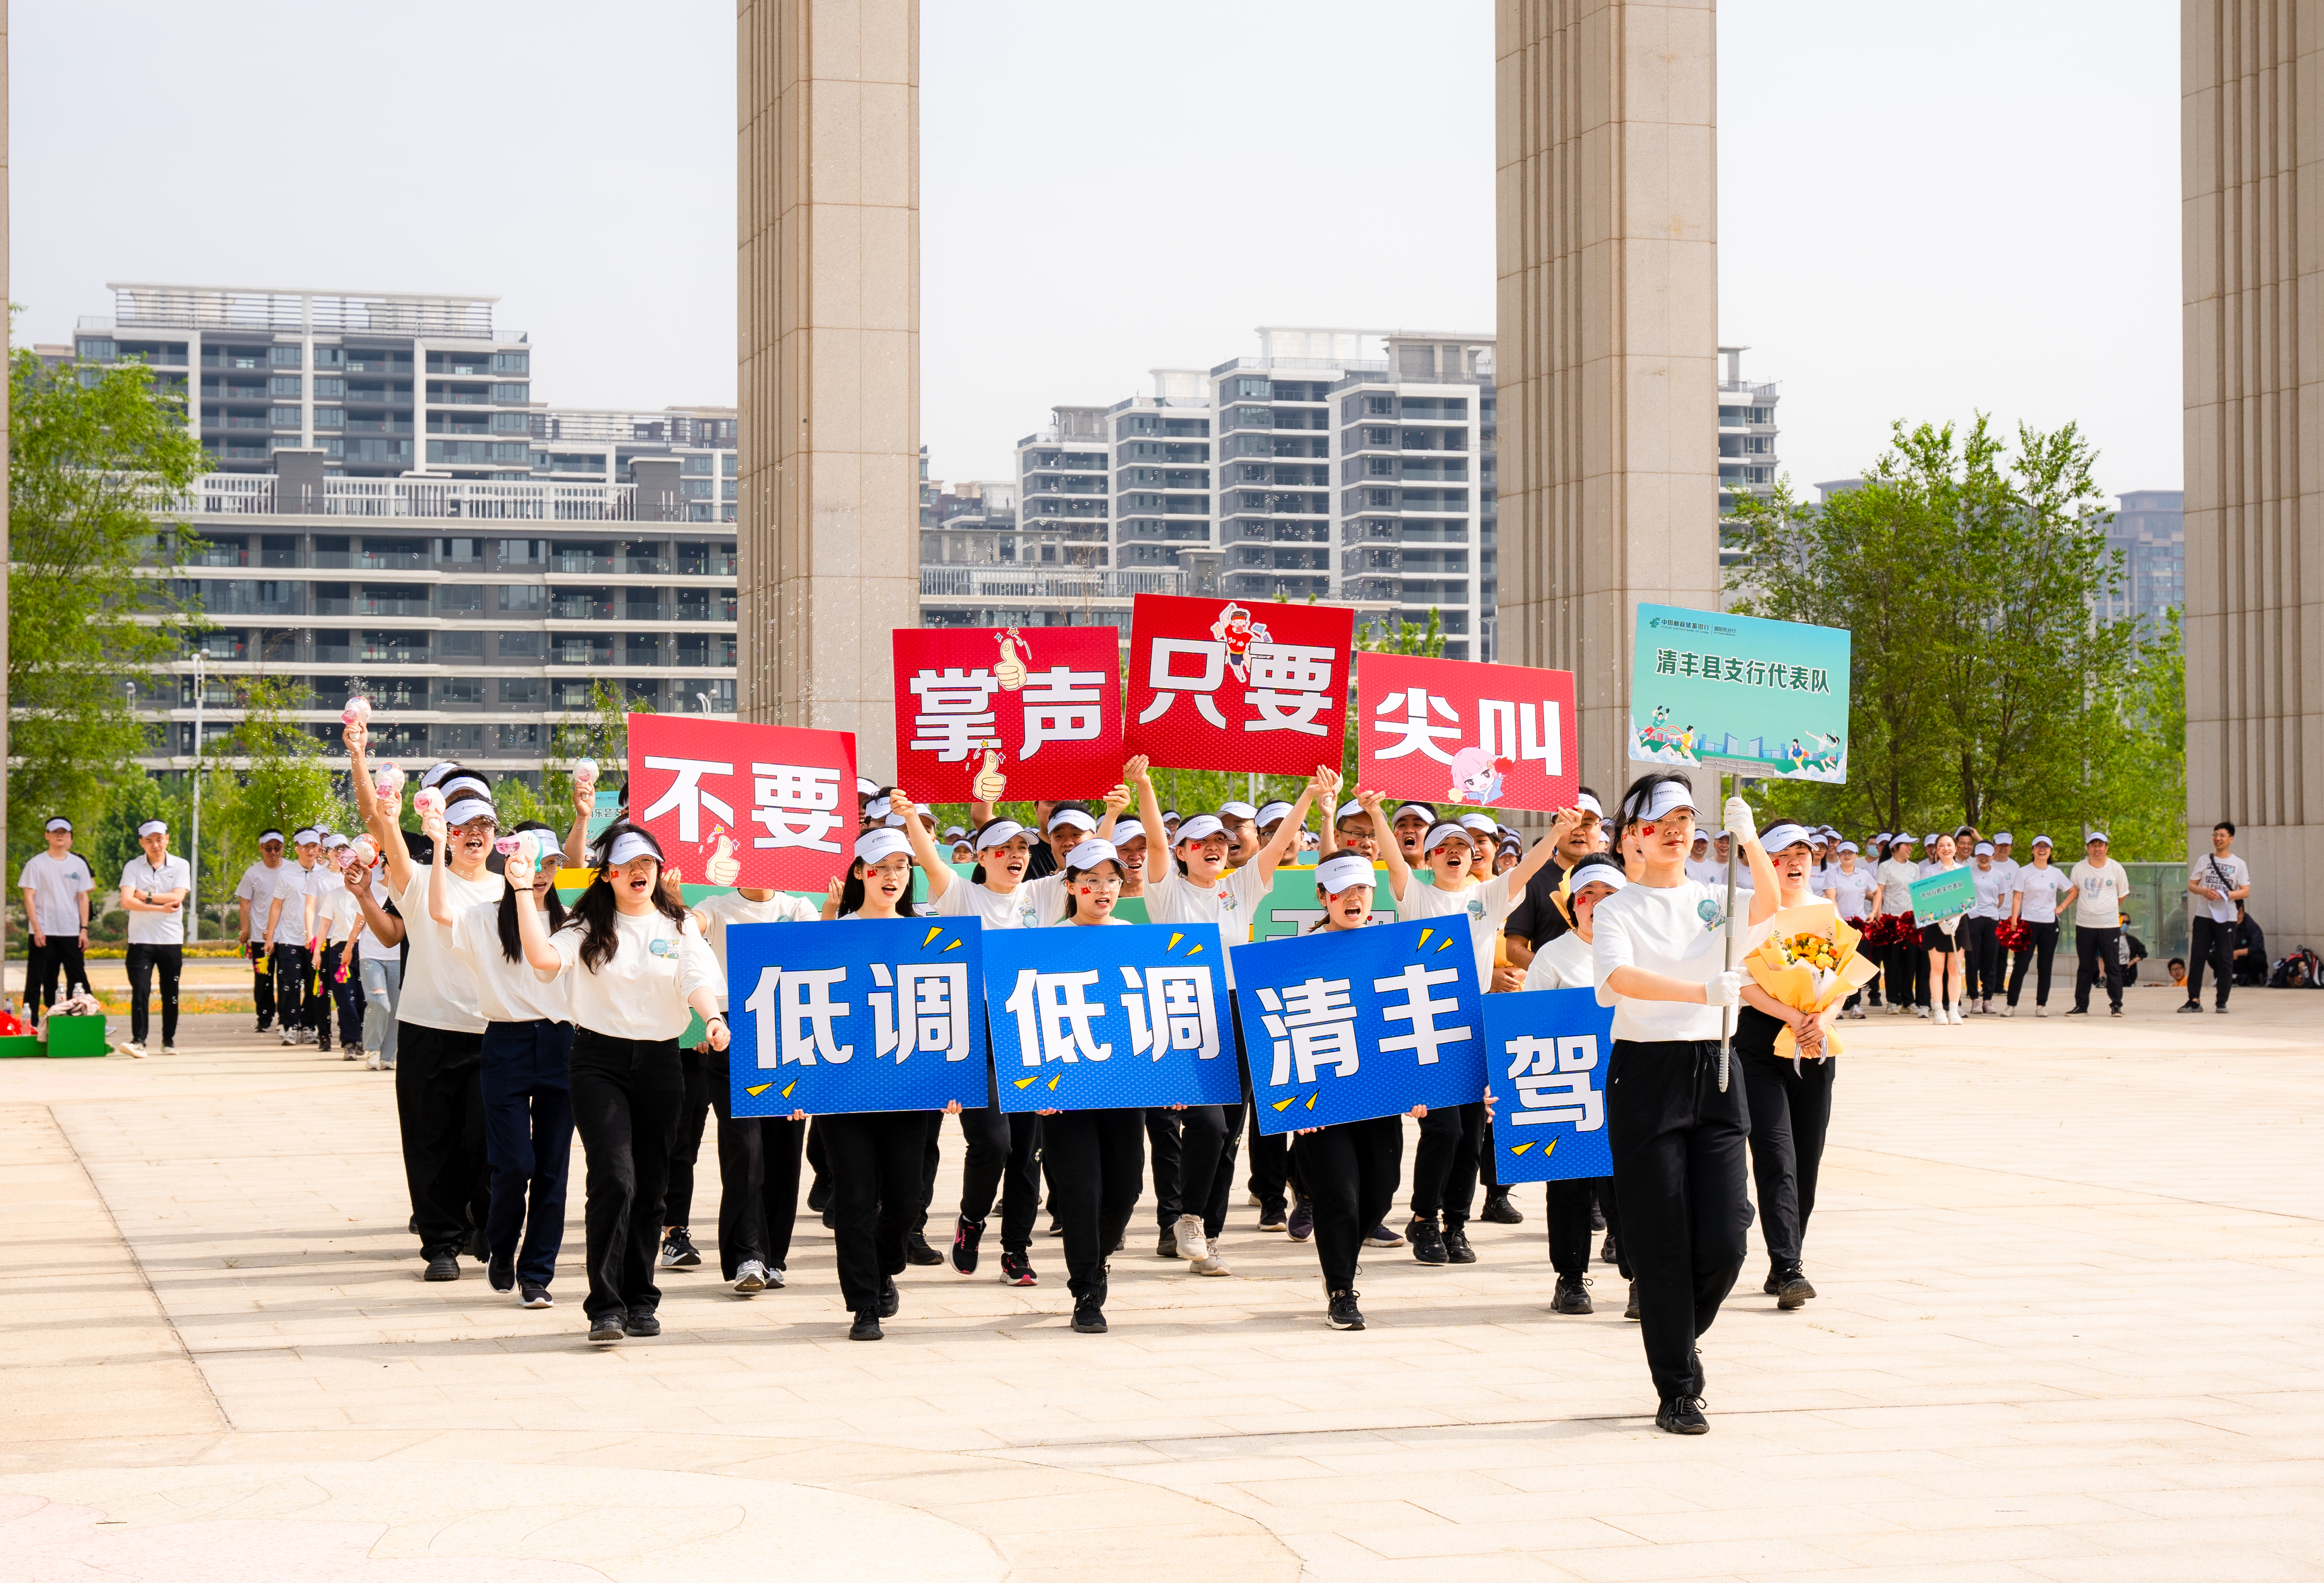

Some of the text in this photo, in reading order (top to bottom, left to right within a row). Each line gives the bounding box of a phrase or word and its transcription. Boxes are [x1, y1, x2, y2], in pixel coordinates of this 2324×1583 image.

[1656, 649, 1830, 695] 清丰县支行代表队
[1662, 619, 1709, 631] 中国邮政储蓄银行
[910, 665, 1105, 762] 掌声
[1139, 637, 1335, 736] 只要
[1374, 687, 1562, 777] 尖叫
[644, 755, 844, 854] 不要
[1921, 882, 1963, 899] 市分行机关代表队
[745, 963, 970, 1069] 低调
[1005, 966, 1220, 1067] 低调
[1255, 964, 1473, 1087] 清丰
[1505, 1034, 1604, 1132] 驾
